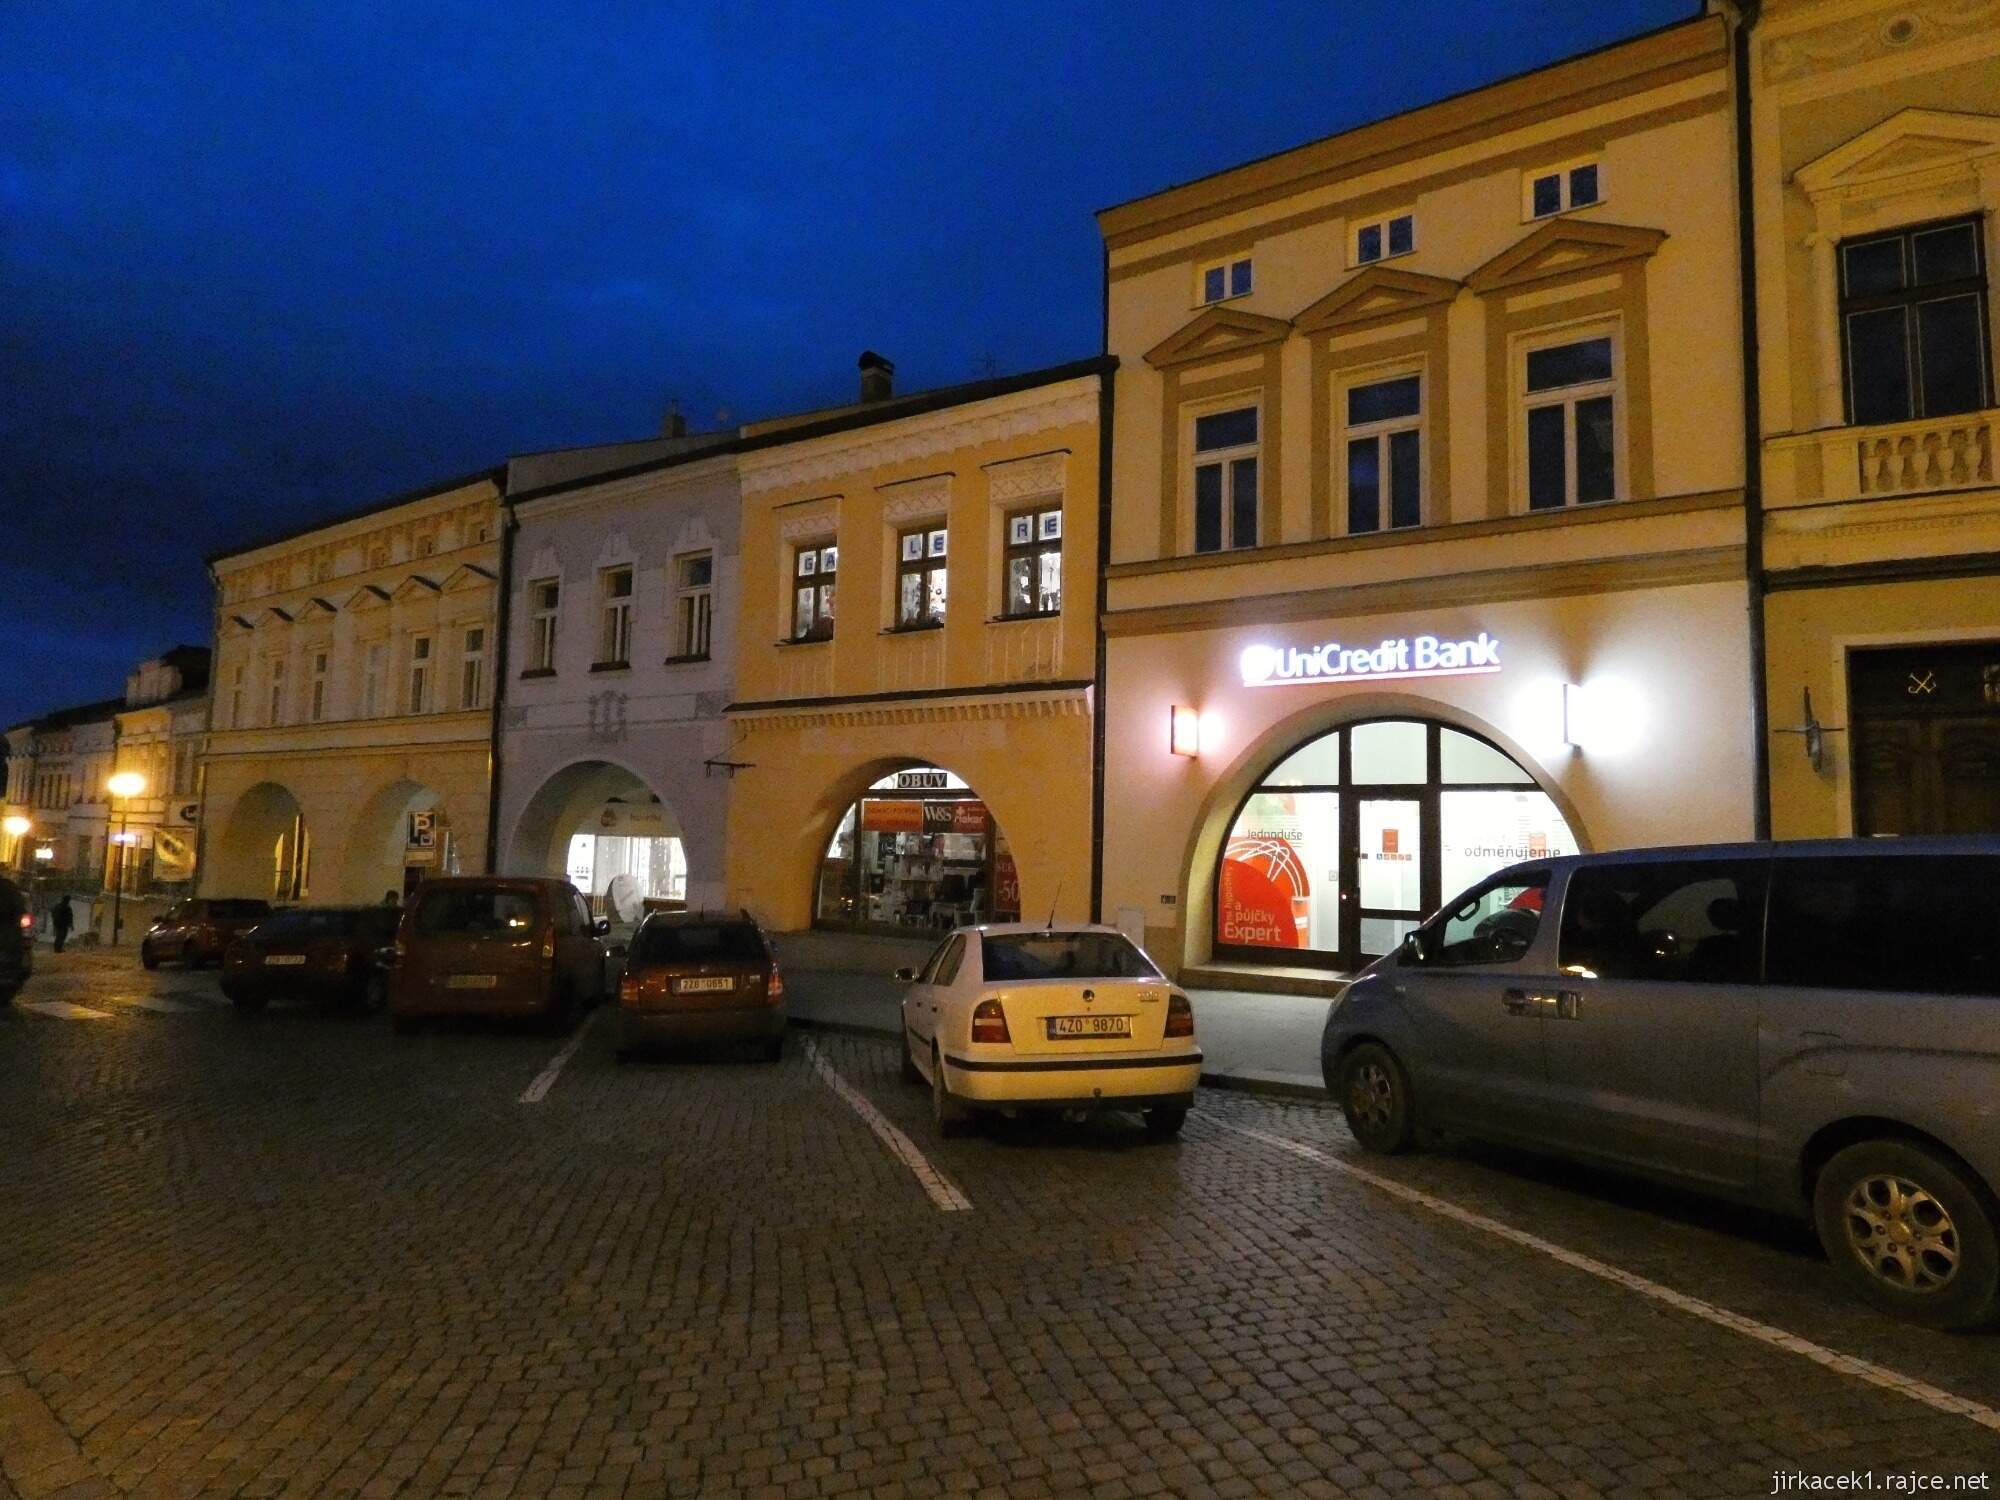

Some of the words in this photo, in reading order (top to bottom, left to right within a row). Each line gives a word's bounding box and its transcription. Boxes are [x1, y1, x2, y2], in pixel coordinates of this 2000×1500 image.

[1275, 640, 1409, 677] UniCredit
[1414, 633, 1500, 669] Bank
[899, 773, 947, 788] OBUV
[1247, 828, 1303, 841] Jednoduše
[1224, 922, 1282, 944] Expert
[1093, 1016, 1124, 1032] 9870
